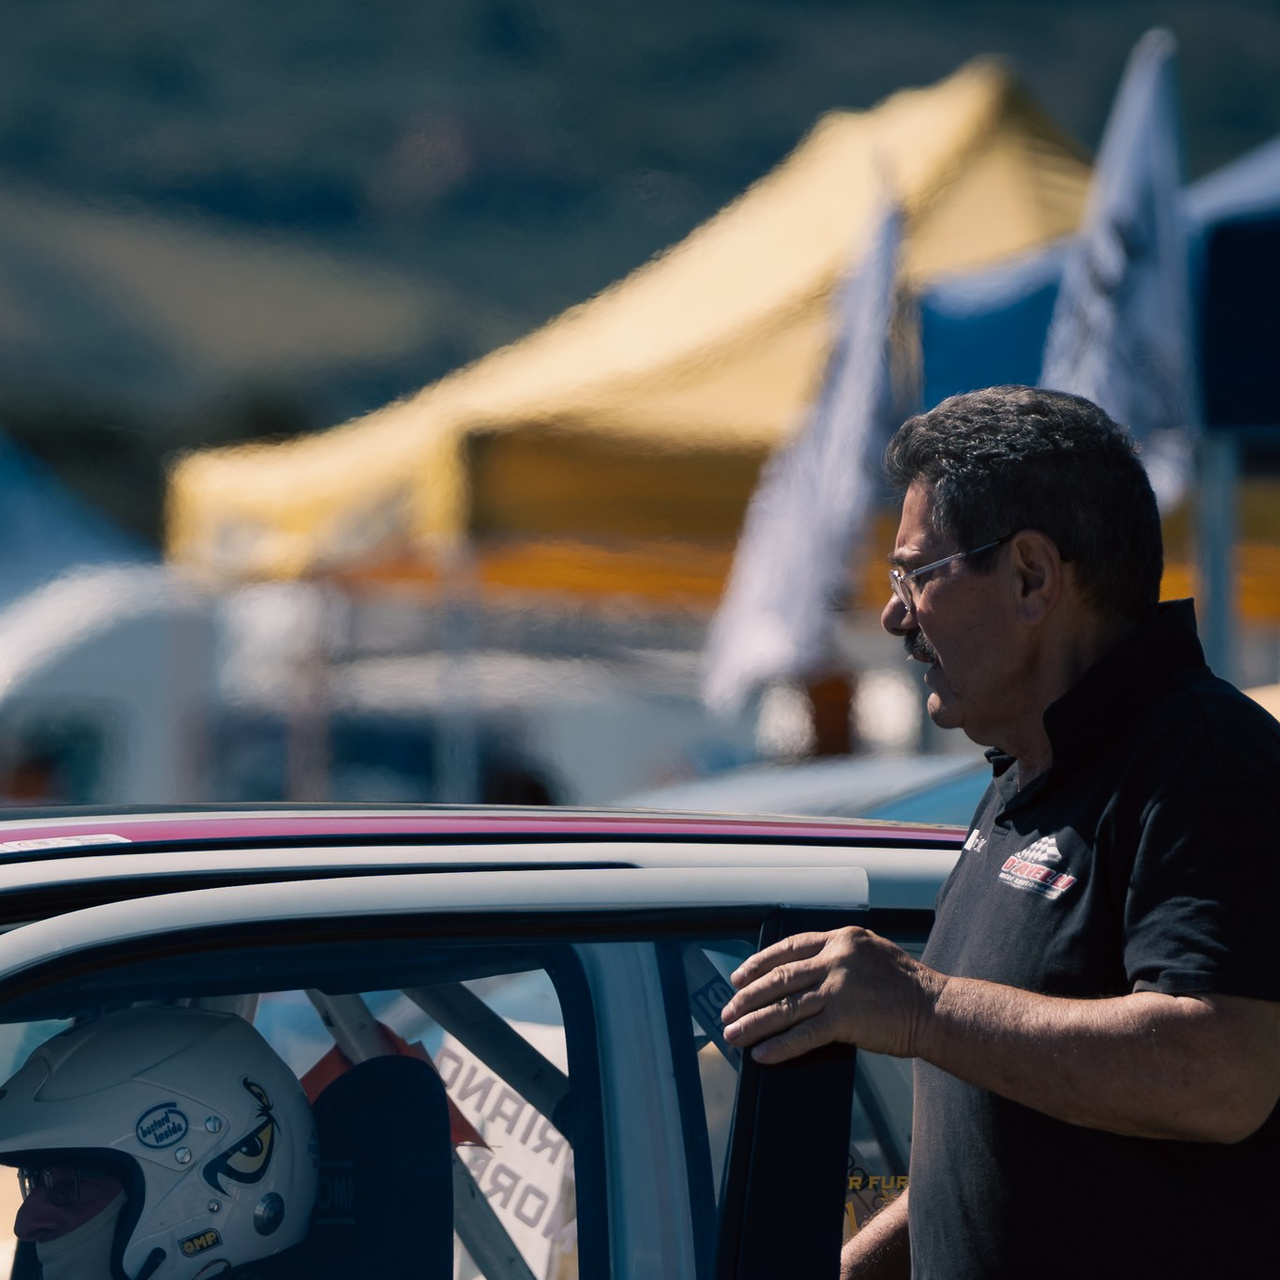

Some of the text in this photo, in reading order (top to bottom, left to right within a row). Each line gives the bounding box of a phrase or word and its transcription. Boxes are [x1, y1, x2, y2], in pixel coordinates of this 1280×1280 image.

[140, 1111, 170, 1138] bastard
[153, 1122, 182, 1144] inside
[183, 1231, 217, 1254] OMP
